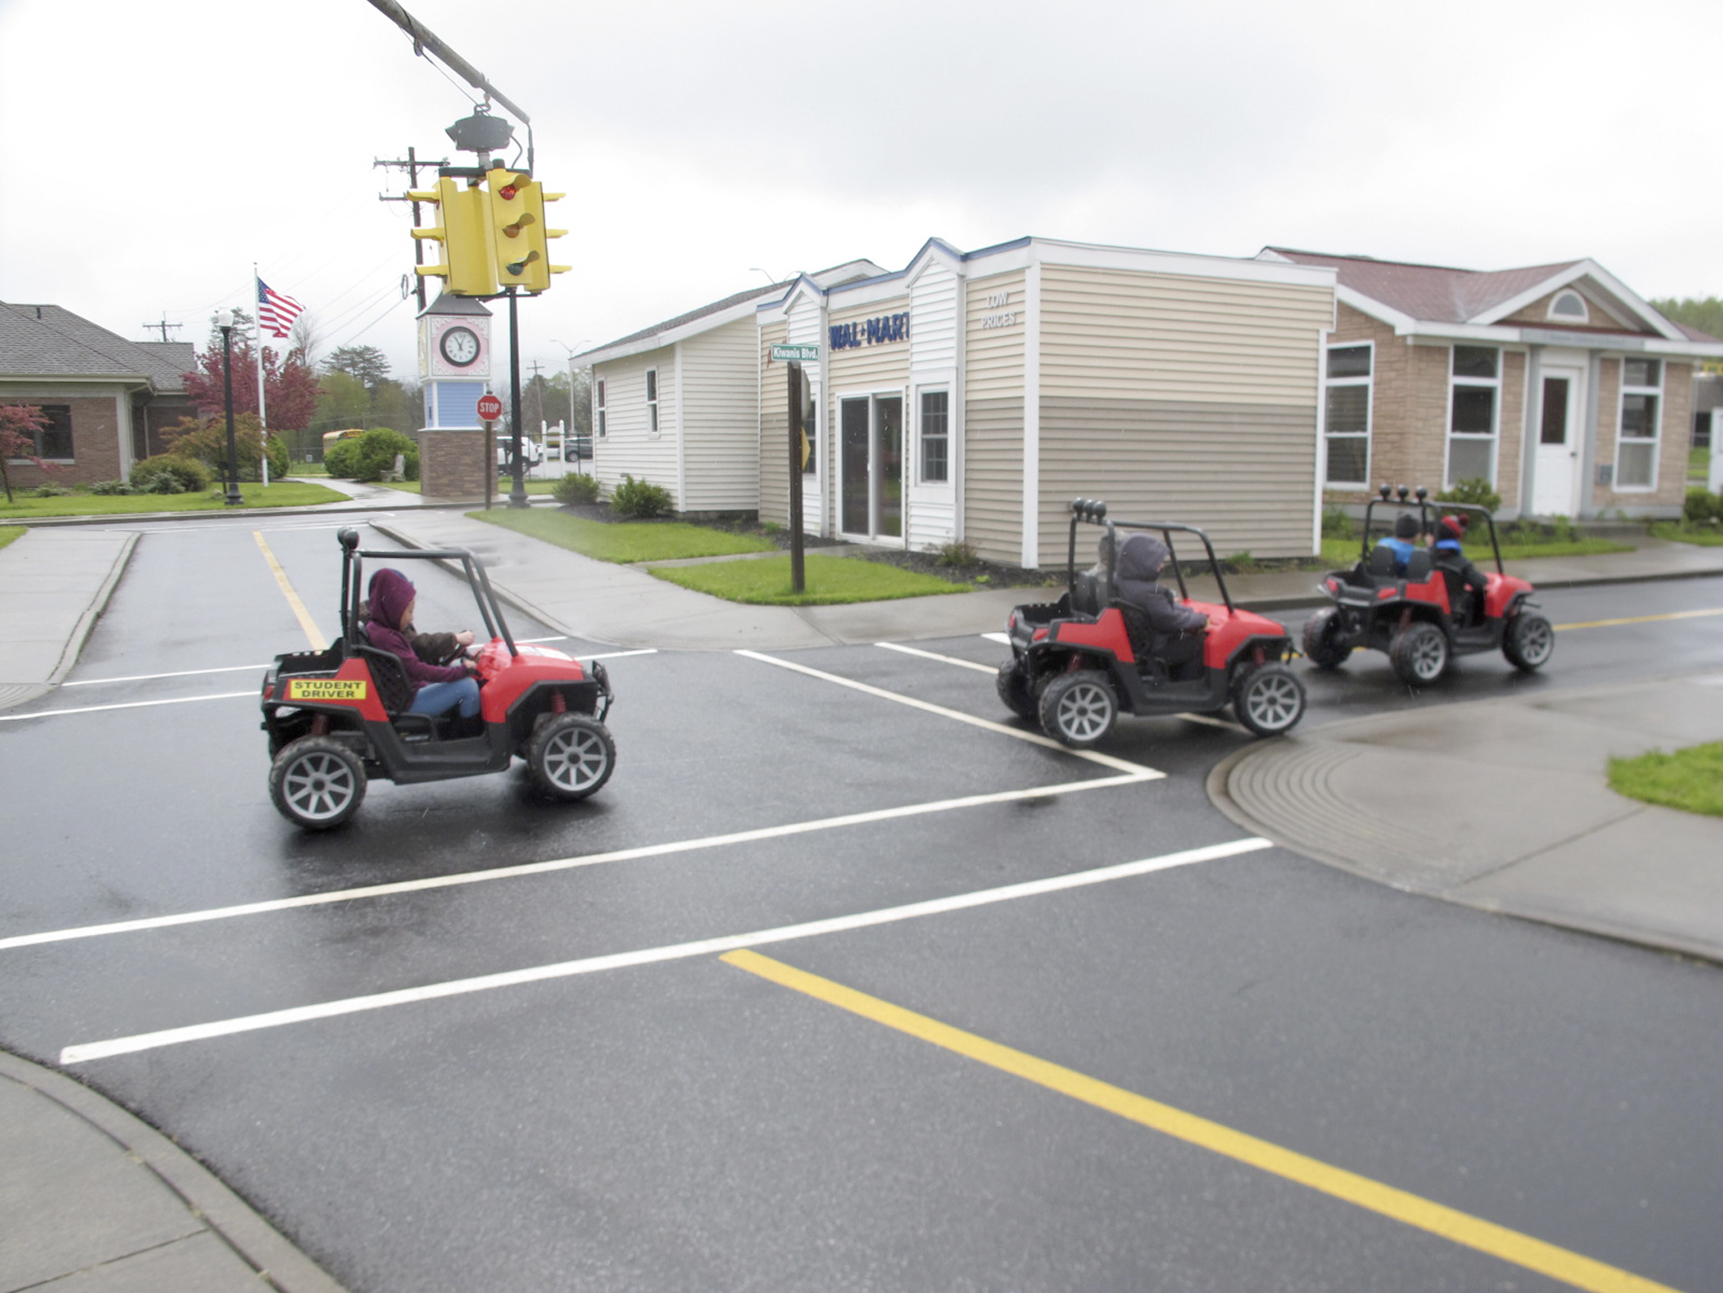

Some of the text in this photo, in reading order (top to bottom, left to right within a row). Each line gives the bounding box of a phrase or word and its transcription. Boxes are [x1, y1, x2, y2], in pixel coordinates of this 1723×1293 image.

[986, 292, 1008, 308] LOW
[982, 311, 1016, 329] PRICES
[773, 346, 800, 358] Kiwanis
[480, 402, 499, 412] STOP
